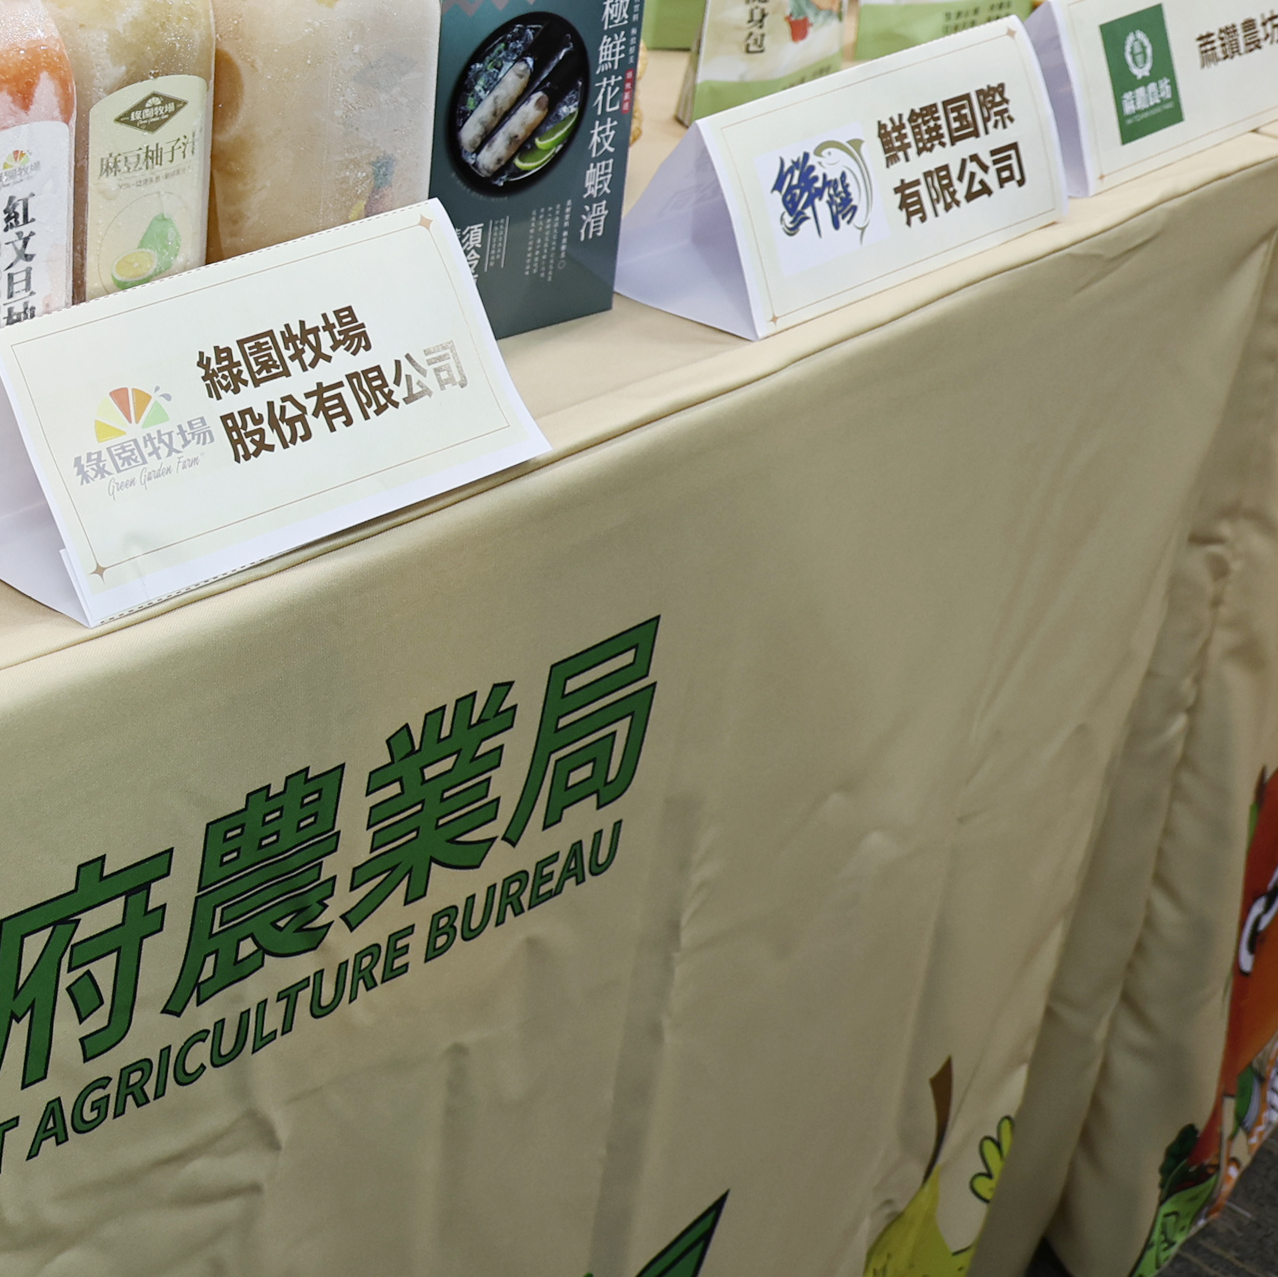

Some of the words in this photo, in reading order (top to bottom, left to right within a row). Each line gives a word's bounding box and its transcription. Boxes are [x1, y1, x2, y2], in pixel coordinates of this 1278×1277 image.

[98, 130, 197, 180] 麻豆柚子汁
[893, 141, 1028, 228] 有限公司
[462, 223, 484, 283] 須冷
[196, 304, 373, 401] 綠園牧場
[219, 339, 469, 465] 股份有限公司
[73, 416, 215, 486] 綠園牧場
[108, 476, 138, 501] Green
[140, 462, 173, 490] Garden
[27, 925, 416, 1161] AGRICULTURE
[424, 819, 623, 964] BUREAU
